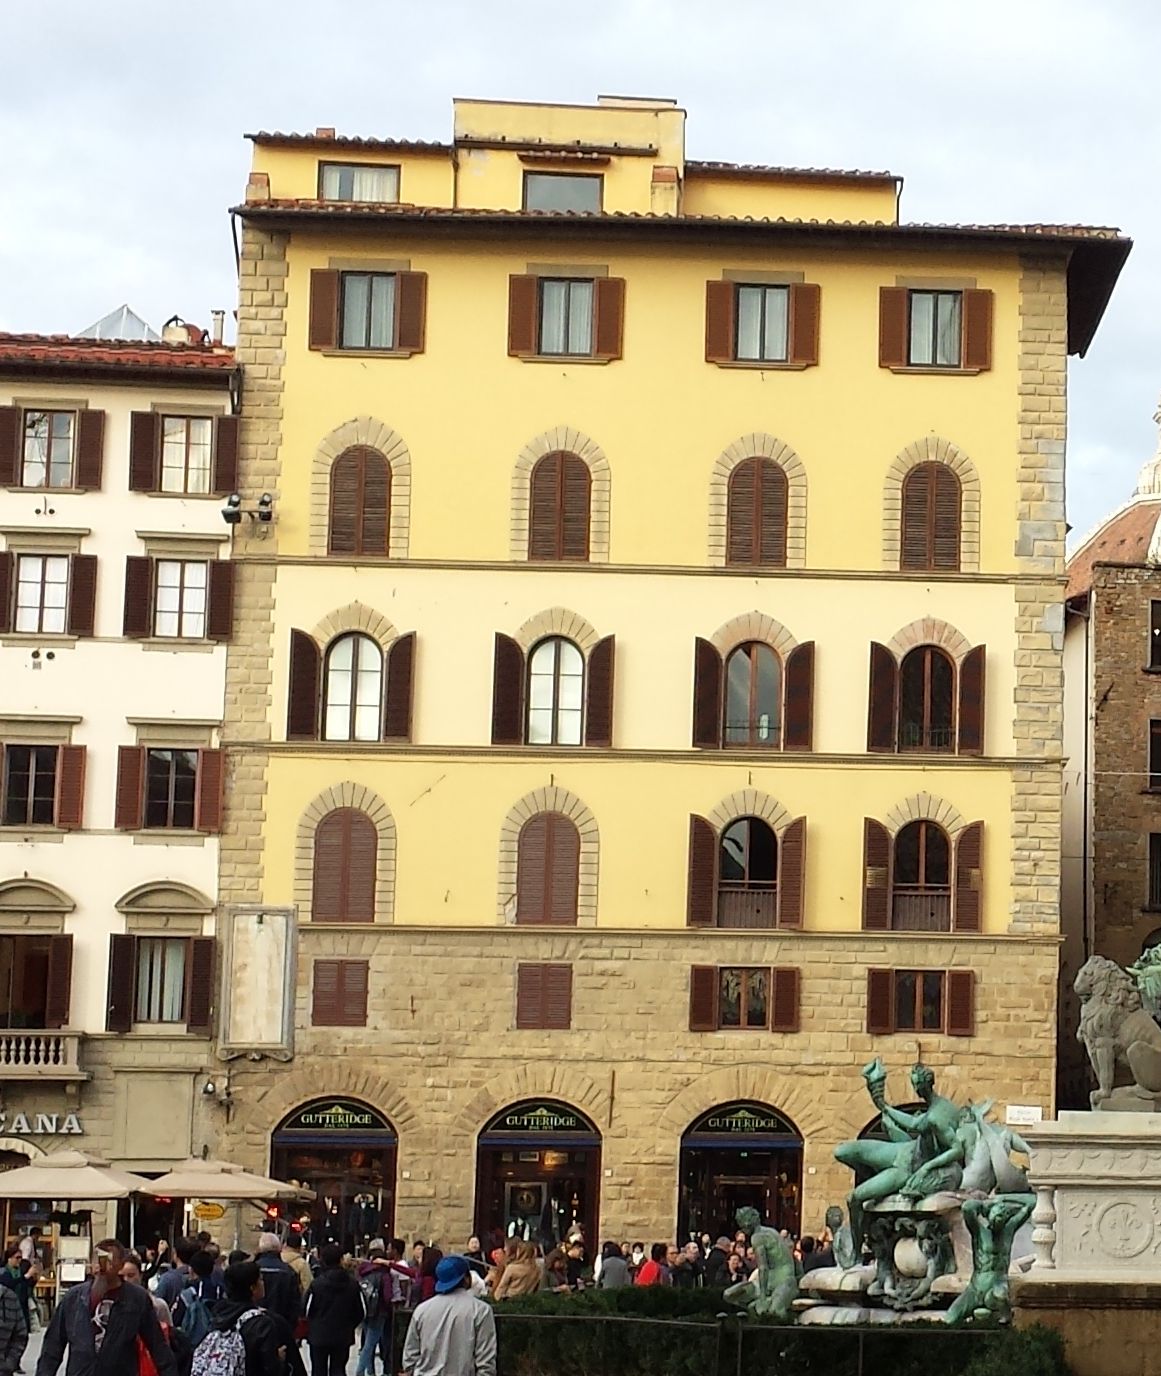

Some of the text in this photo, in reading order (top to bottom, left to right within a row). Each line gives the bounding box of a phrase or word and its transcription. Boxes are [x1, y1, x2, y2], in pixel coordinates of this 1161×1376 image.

[301, 1114, 373, 1124] GUTTERIDGE
[506, 1116, 576, 1126] GUTTERIDGE
[708, 1118, 777, 1128] GUTTERIDGE
